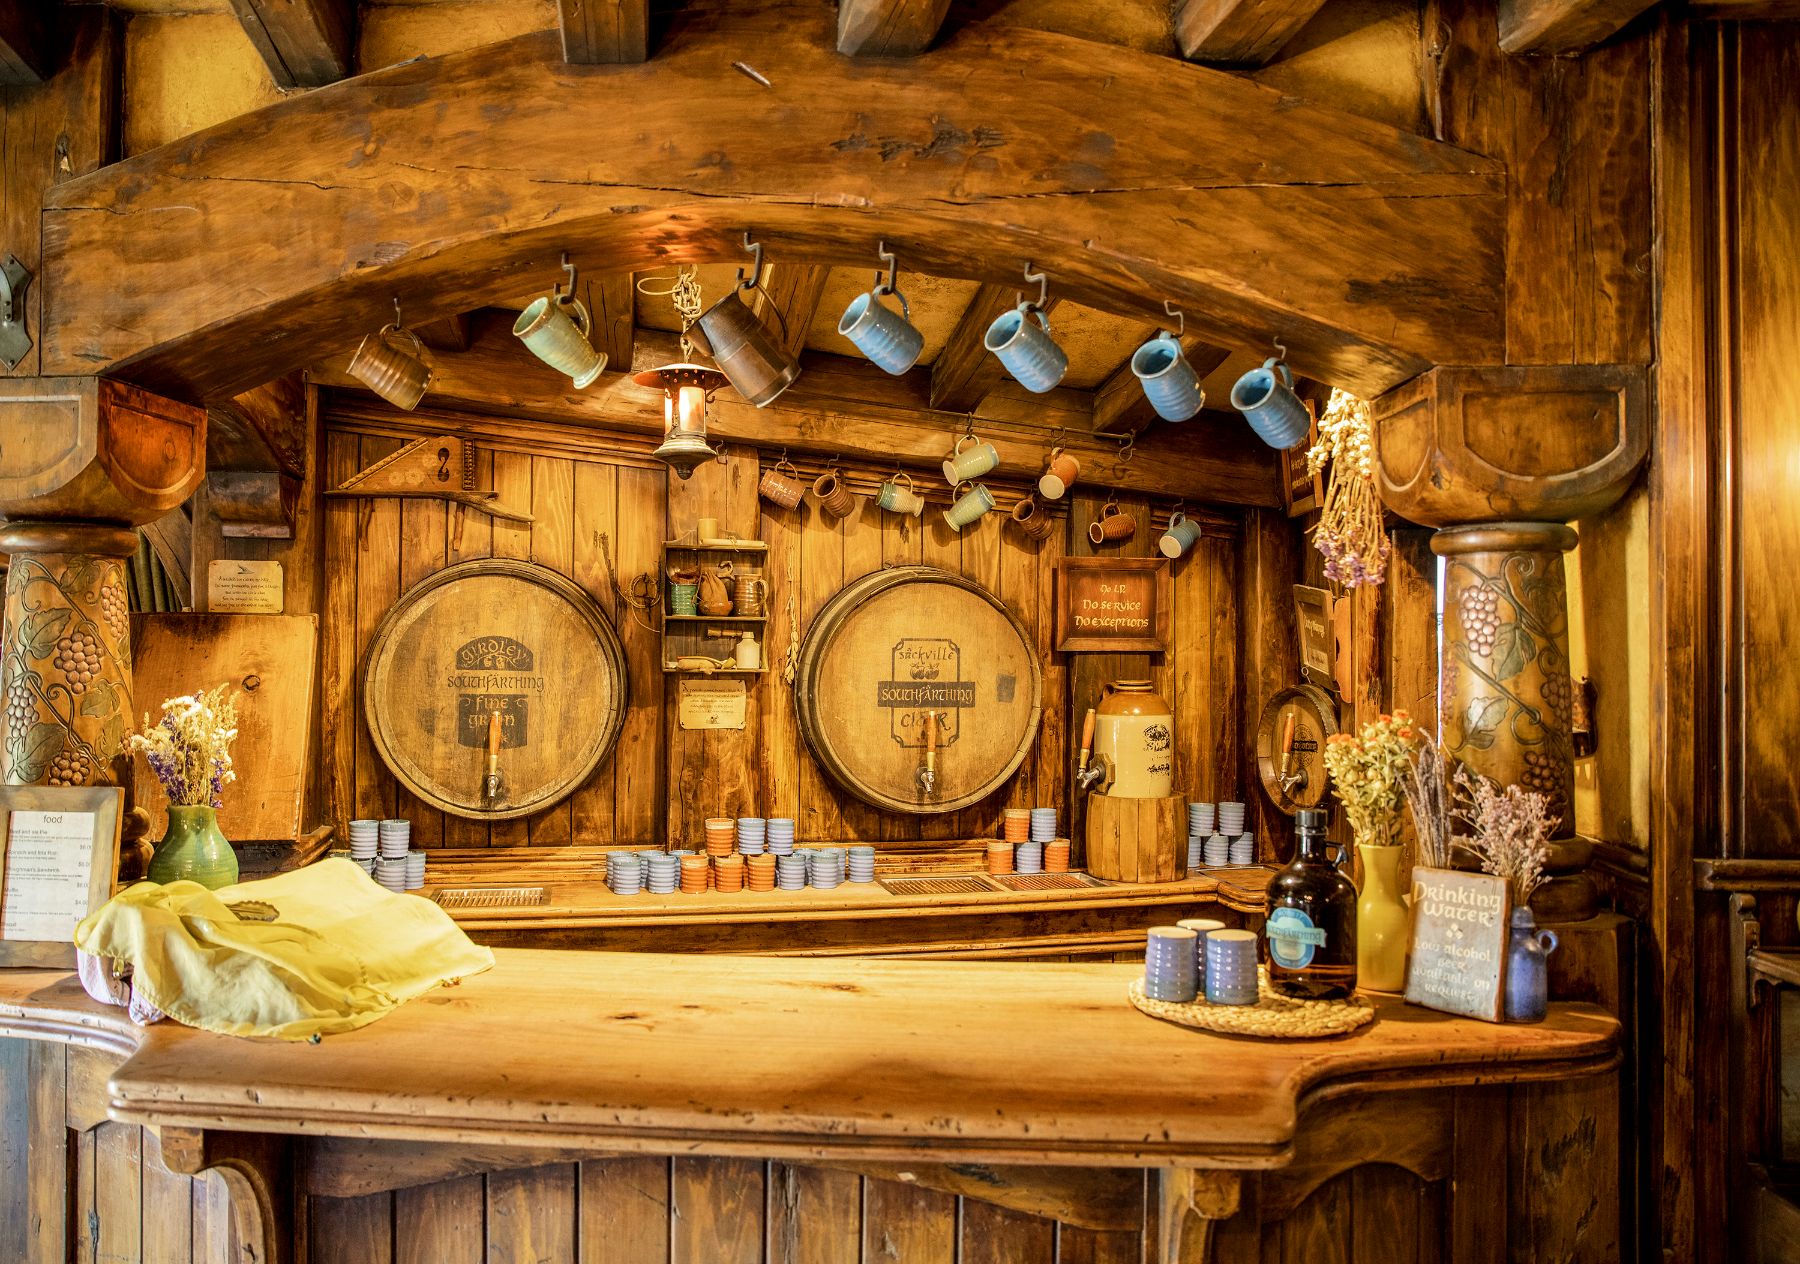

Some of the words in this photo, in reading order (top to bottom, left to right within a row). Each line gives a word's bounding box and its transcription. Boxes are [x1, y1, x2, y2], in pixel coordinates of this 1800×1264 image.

[1100, 584, 1112, 595] No
[1082, 599, 1099, 612] No
[1074, 615, 1091, 629] No
[43, 814, 63, 824] food
[1413, 881, 1501, 915] Drinking
[1443, 943, 1492, 961] alcohol
[1473, 977, 1490, 991] on
